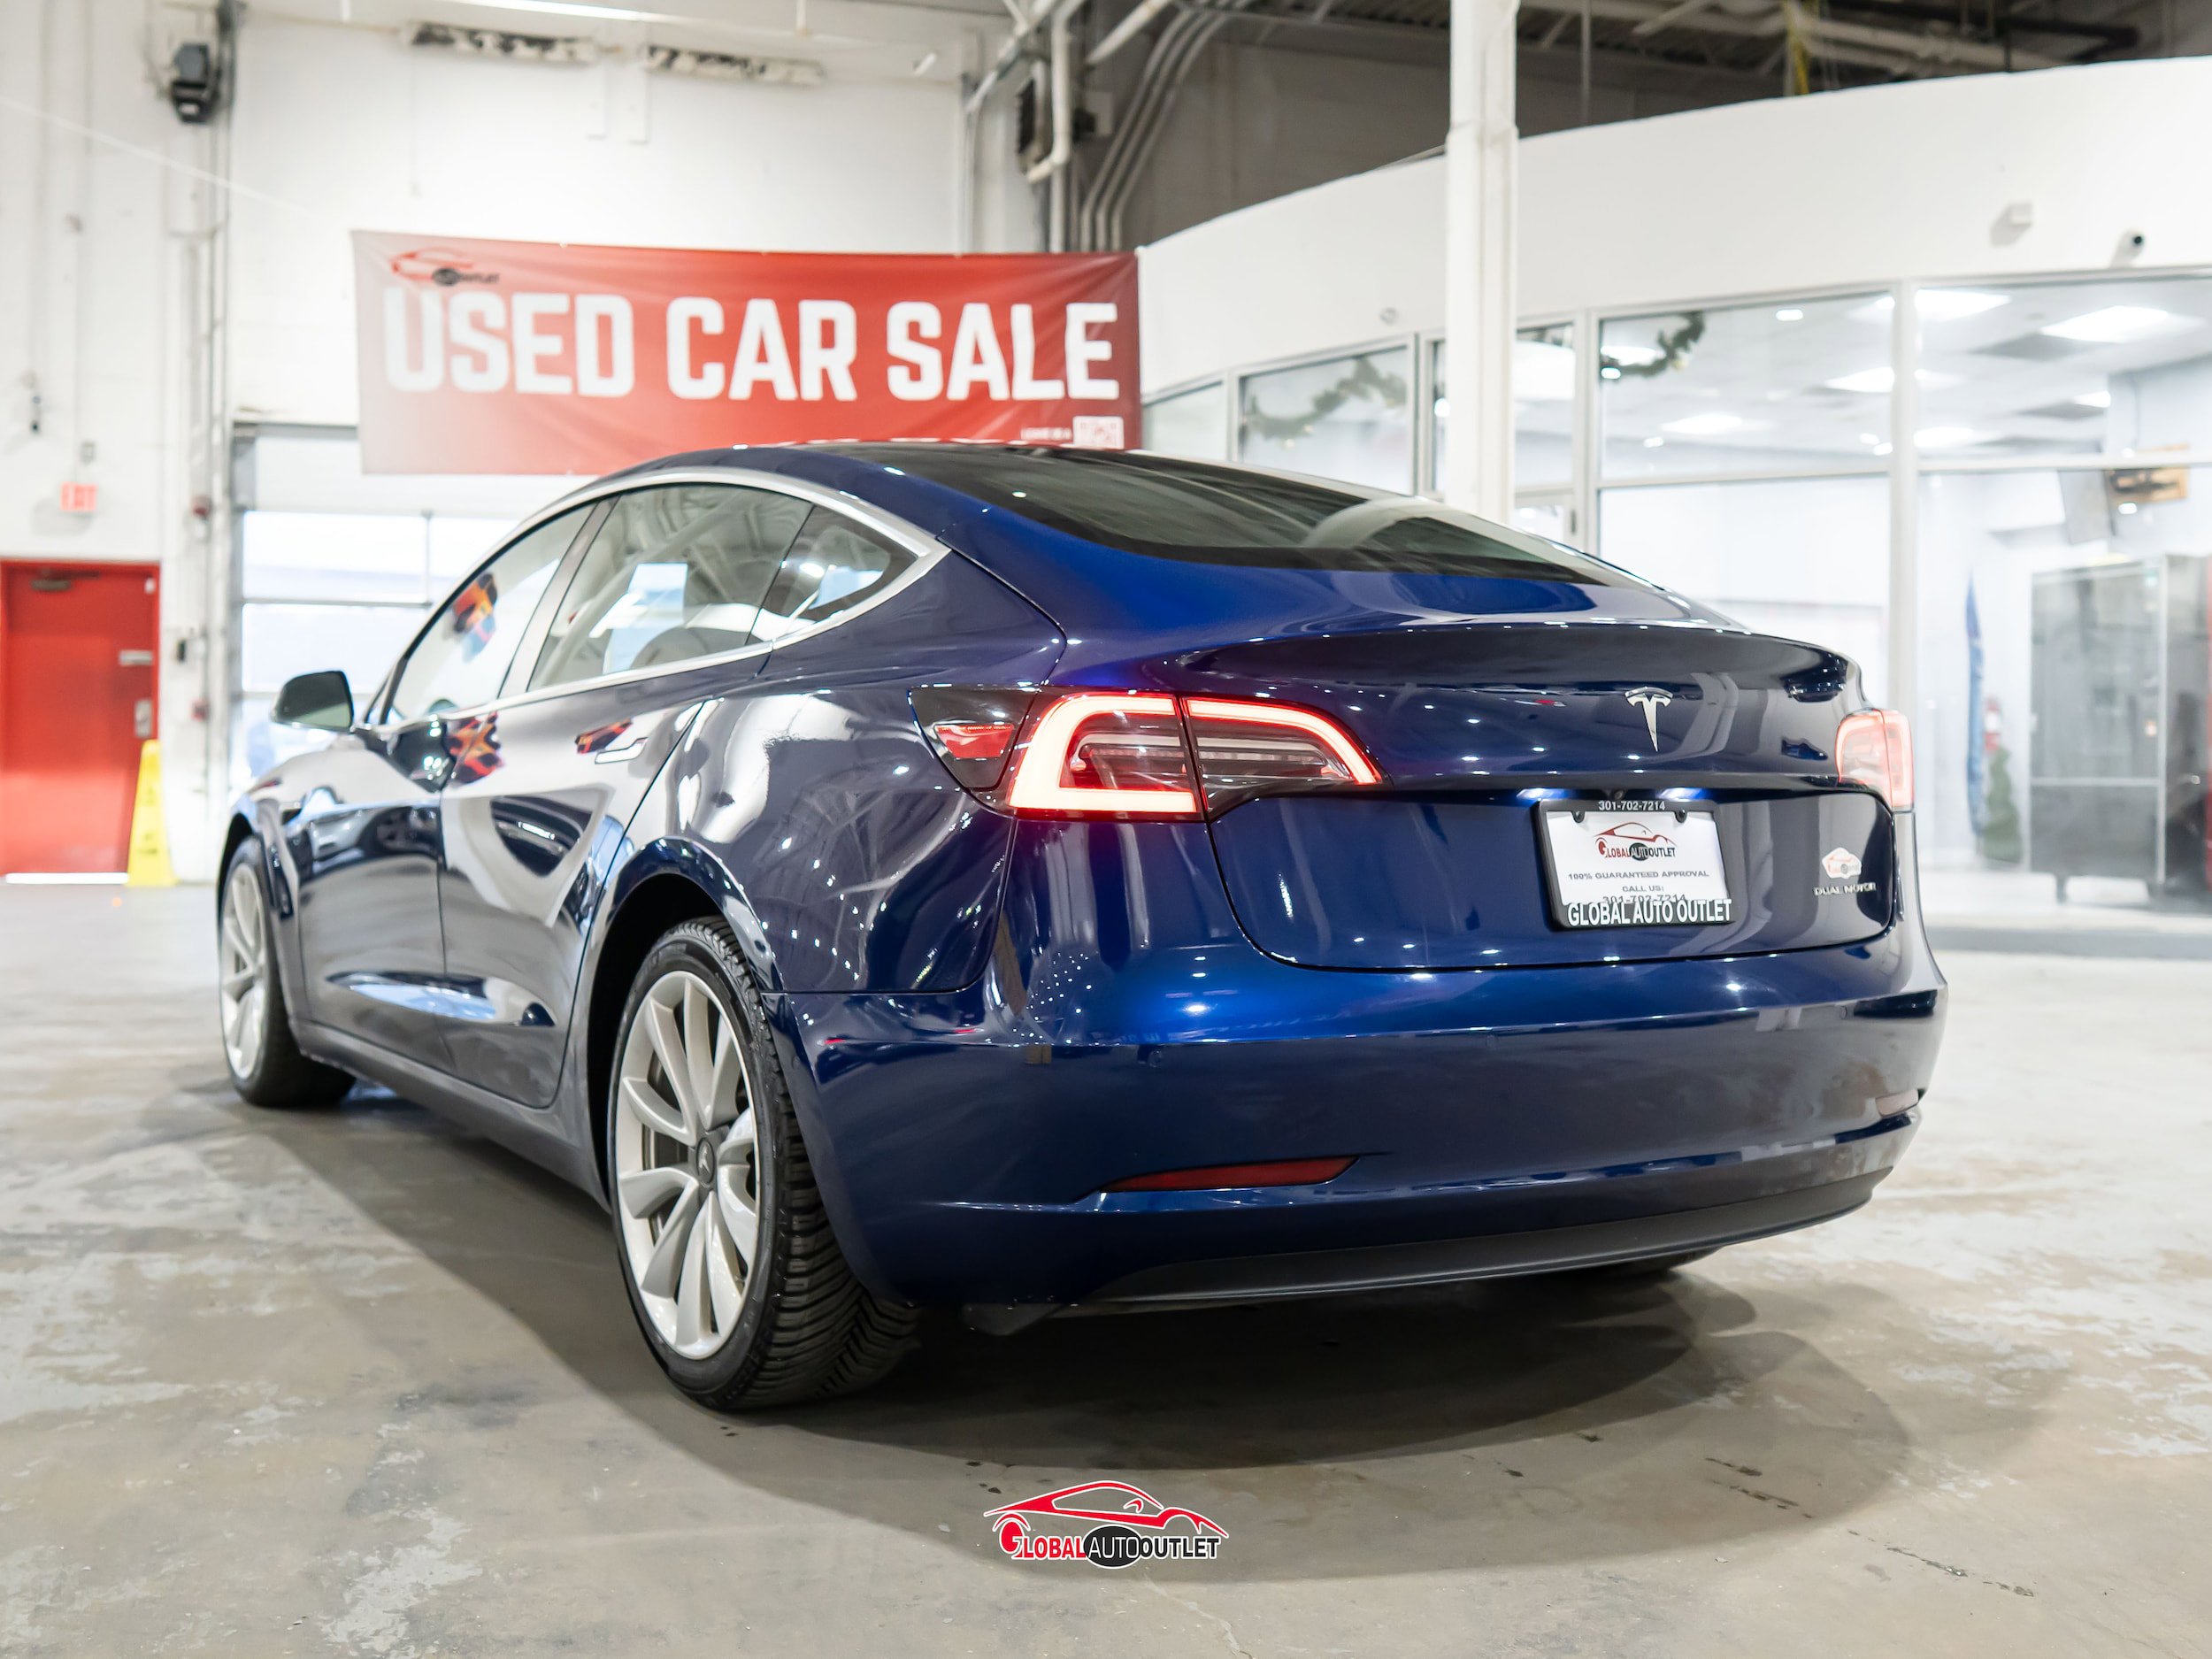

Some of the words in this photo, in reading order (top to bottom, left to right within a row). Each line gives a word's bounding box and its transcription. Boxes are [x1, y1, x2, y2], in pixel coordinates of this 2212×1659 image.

[384, 288, 634, 397] USED
[666, 296, 858, 402] CAR
[887, 301, 1120, 402] SALE
[1598, 800, 1666, 810] 301-702-7214
[1813, 887, 1839, 895] DUAL
[1567, 901, 1631, 926] GLOBAL
[1632, 900, 1674, 924] AUTO
[1676, 898, 1732, 923] OUTLET
